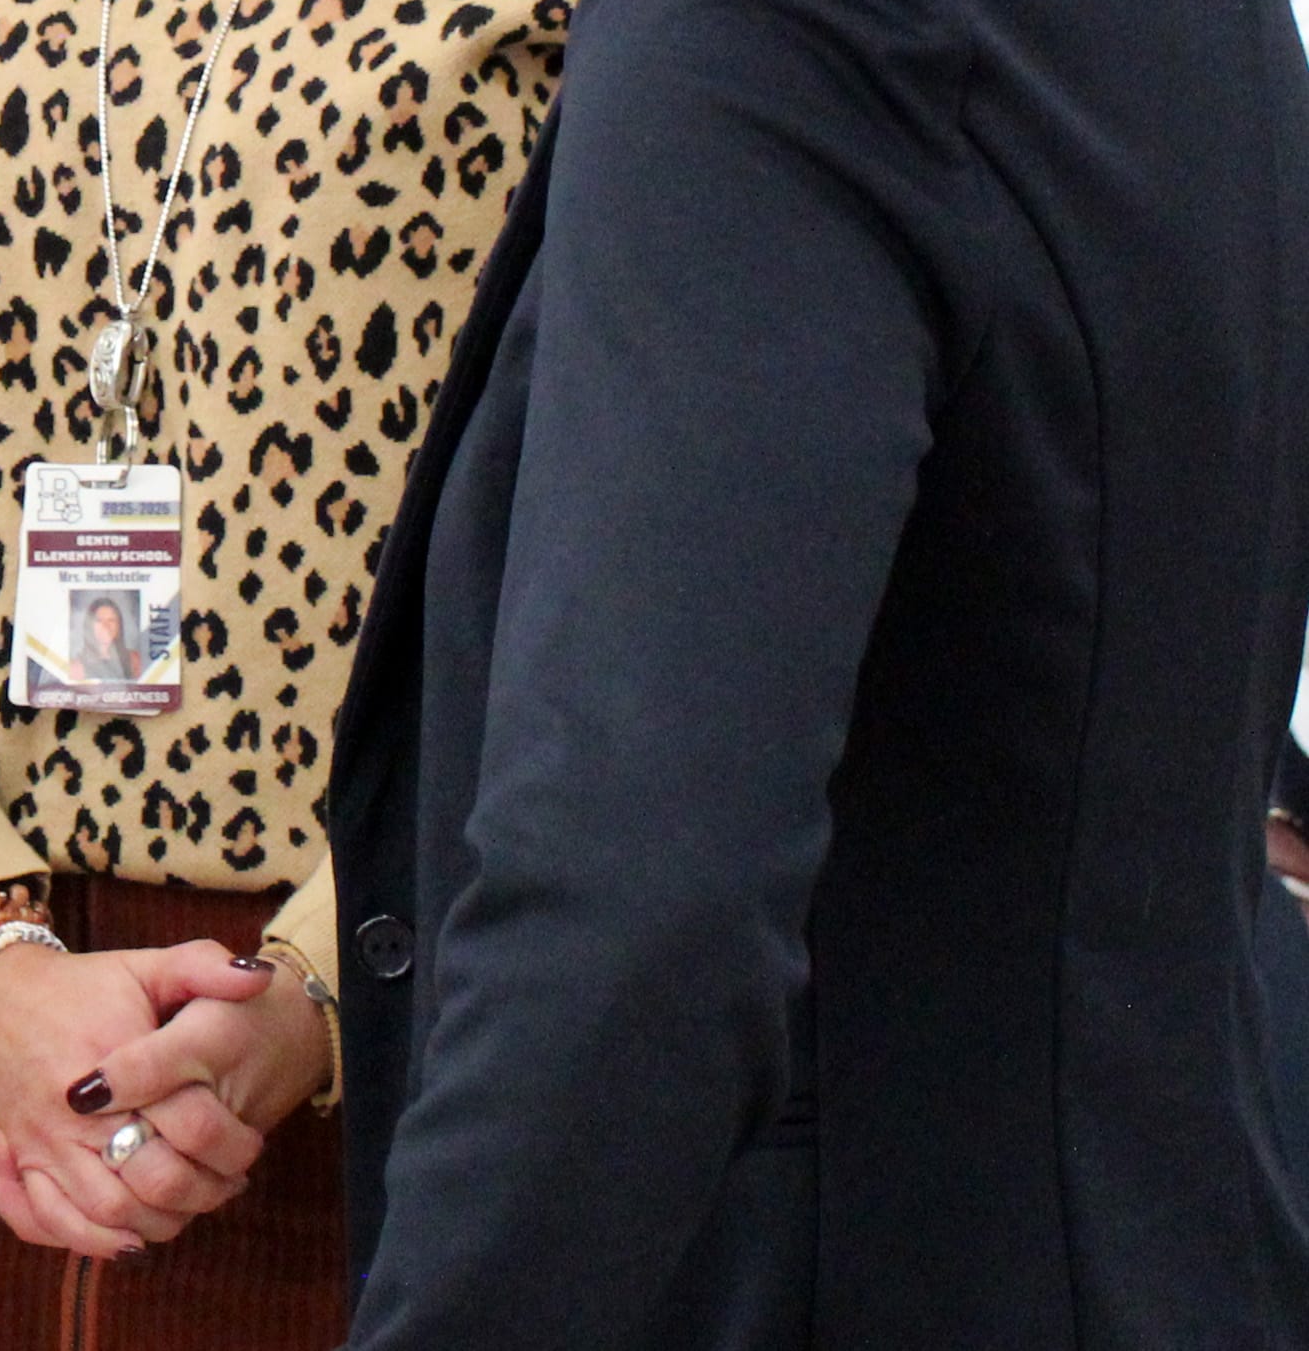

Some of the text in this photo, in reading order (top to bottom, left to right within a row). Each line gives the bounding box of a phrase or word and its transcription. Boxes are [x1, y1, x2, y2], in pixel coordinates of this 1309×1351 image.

[76, 534, 129, 546] BENTON
[33, 550, 173, 562] ELEMENTARY SCHOOL
[58, 571, 81, 582] Mrs.
[148, 603, 170, 660] STAFF
[101, 690, 170, 702] GREATNESS
